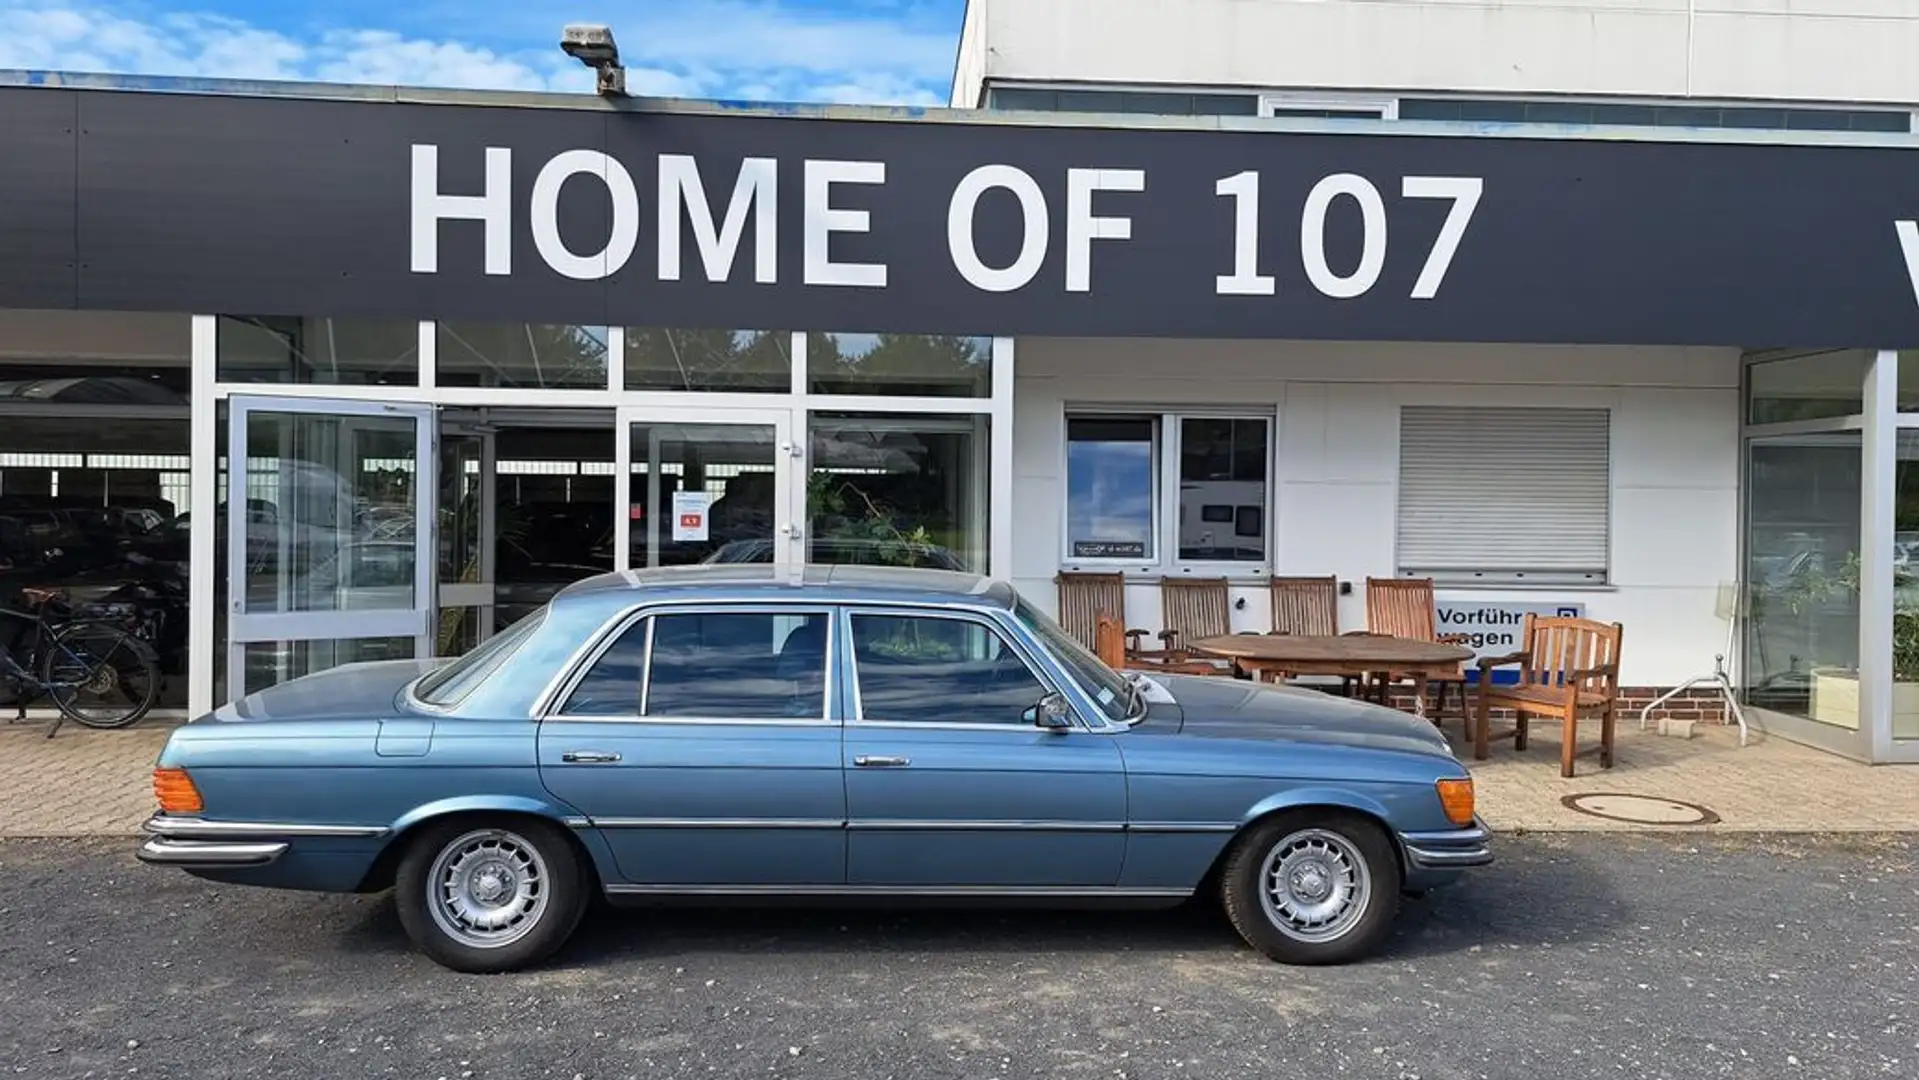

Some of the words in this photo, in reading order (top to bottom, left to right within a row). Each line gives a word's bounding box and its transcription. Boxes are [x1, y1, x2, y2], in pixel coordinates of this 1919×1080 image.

[411, 144, 886, 287] HOME
[948, 165, 1144, 292] OF
[1216, 172, 1483, 299] 107
[1438, 608, 1523, 625] Vorführ
